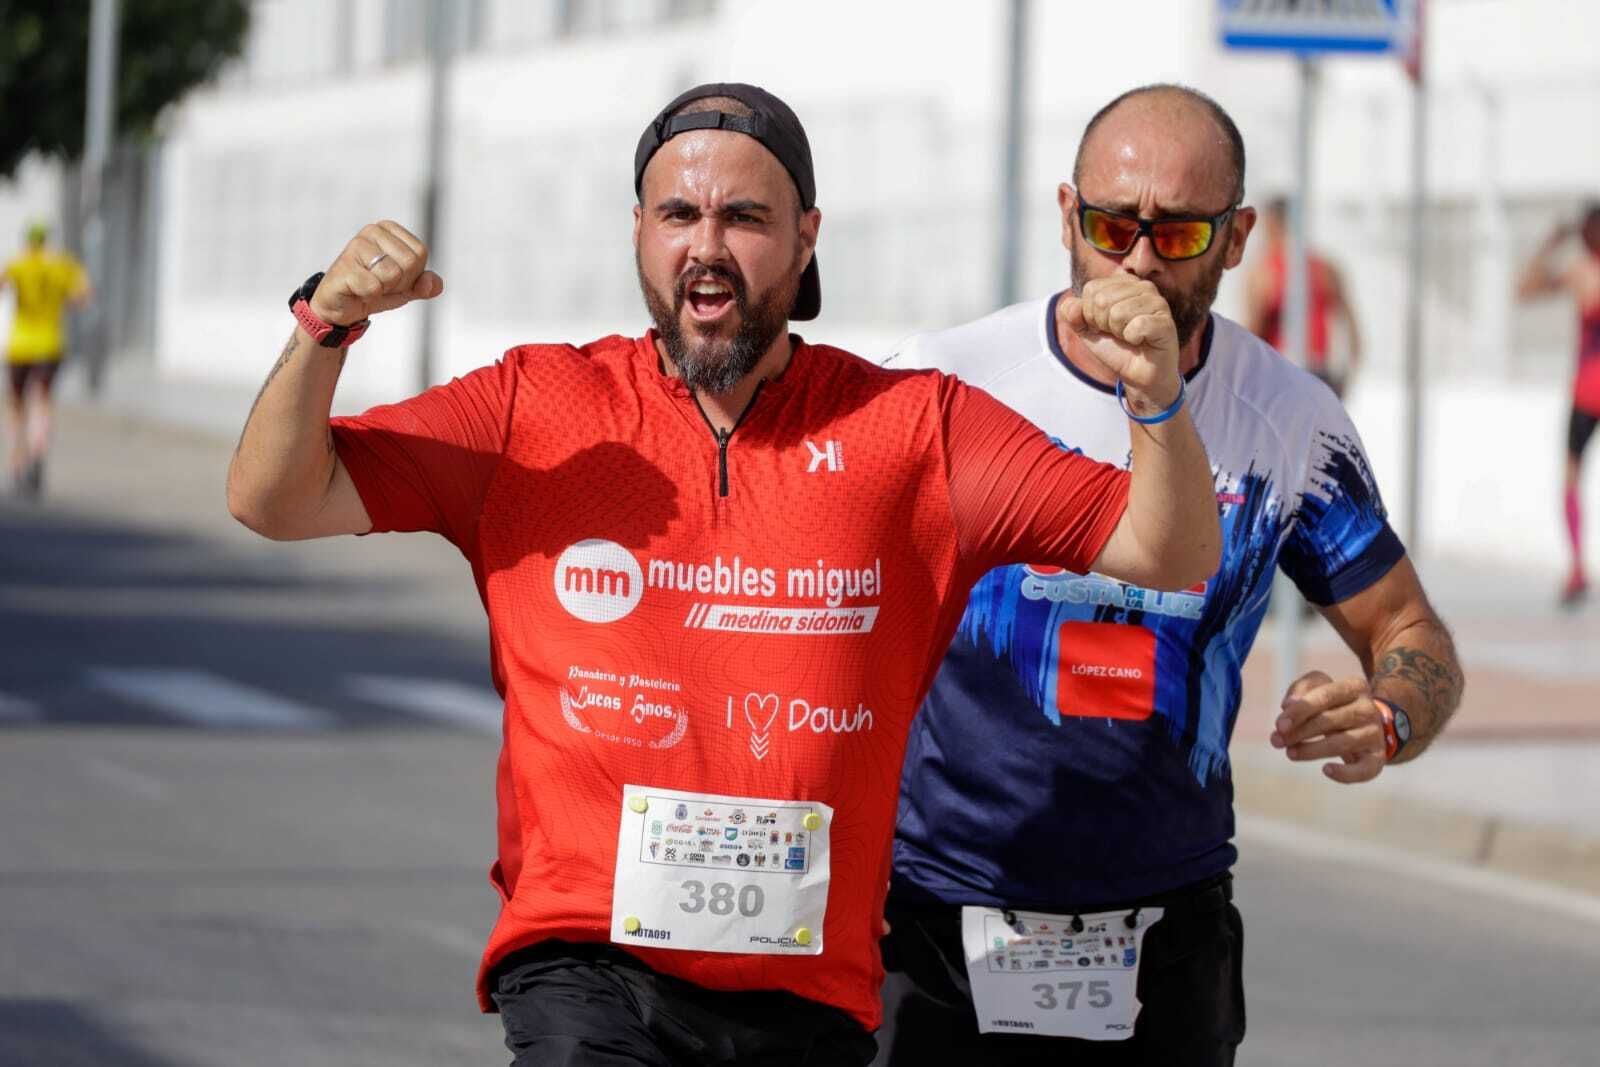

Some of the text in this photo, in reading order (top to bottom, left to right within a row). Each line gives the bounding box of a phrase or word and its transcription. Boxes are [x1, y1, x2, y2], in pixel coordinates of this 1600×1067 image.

[565, 565, 631, 598] mm
[648, 556, 881, 607] muebles miguel
[1126, 588, 1146, 599] DE
[718, 606, 863, 632] medina sidonia
[1072, 663, 1142, 679] LÓPEZ CANO
[570, 685, 622, 710] Lucas
[726, 695, 733, 729] I
[678, 880, 765, 918] 380
[1031, 980, 1113, 1010] 375
